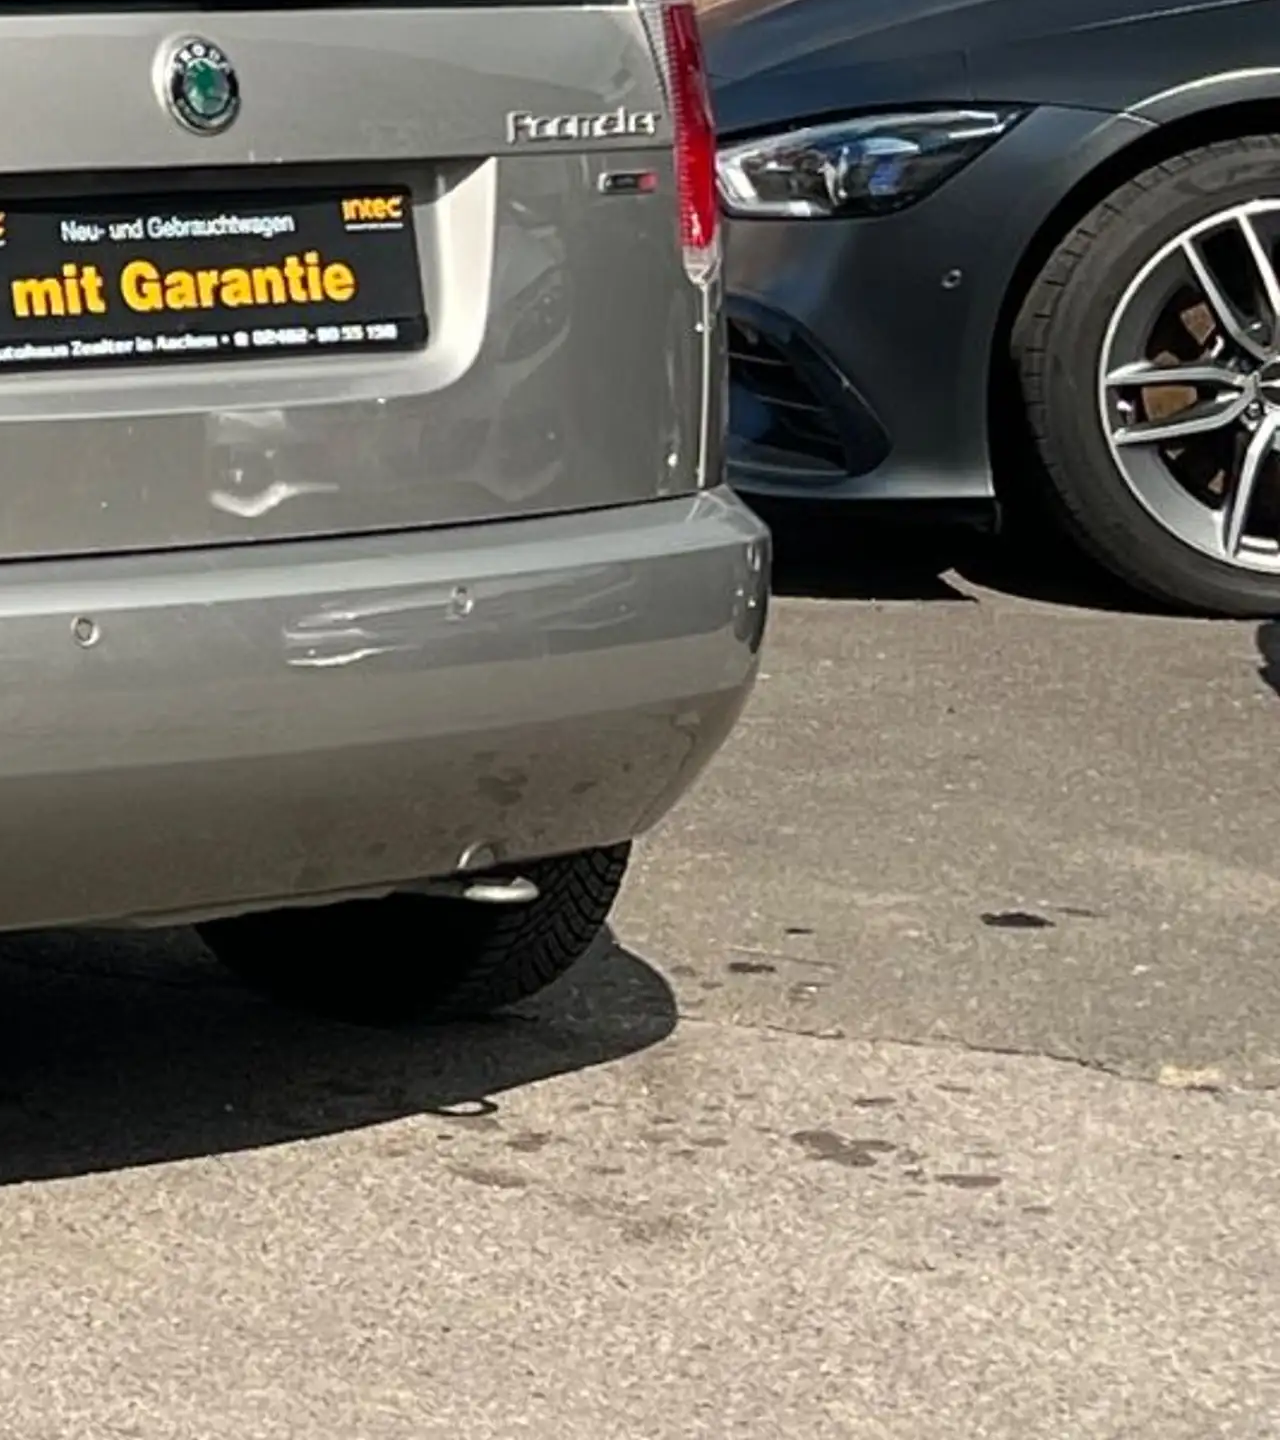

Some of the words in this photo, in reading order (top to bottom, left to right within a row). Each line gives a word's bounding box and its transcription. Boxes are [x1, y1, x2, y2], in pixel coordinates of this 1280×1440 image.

[60, 220, 105, 241] Neu-
[108, 216, 143, 240] und
[147, 214, 295, 238] Gebrauchtwagen
[11, 263, 108, 317] mit
[120, 252, 355, 310] Garantie
